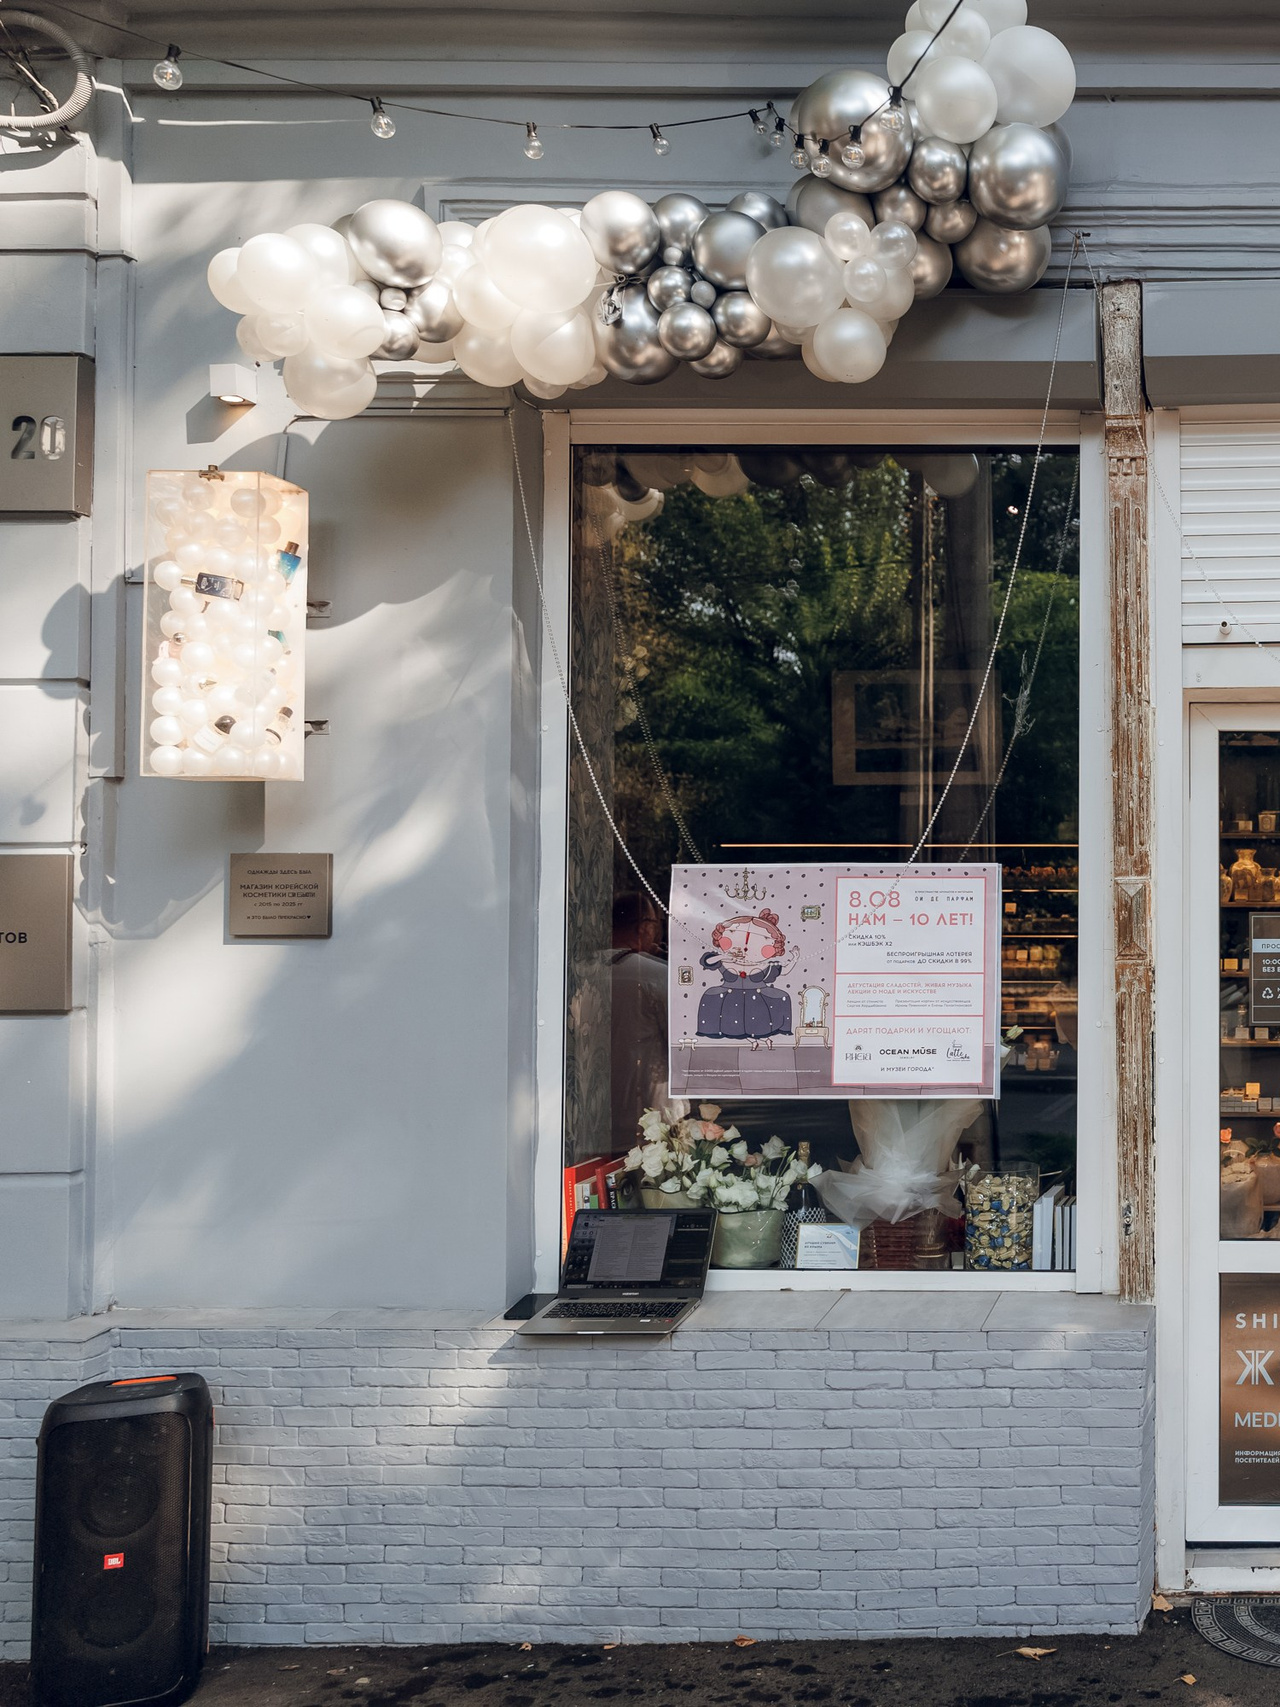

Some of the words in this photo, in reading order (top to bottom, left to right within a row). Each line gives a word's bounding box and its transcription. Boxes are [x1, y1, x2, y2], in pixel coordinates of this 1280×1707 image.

[11, 415, 65, 460] 20
[275, 882, 318, 890] КОРЕЙСКОЙ
[849, 891, 901, 908] 8.08
[848, 913, 886, 926] НАМ
[909, 913, 929, 926] 10
[936, 913, 973, 926] ЛЕТ!
[846, 1027, 873, 1035] ДАРЯТ
[875, 1027, 917, 1035] ПОДАРКИ
